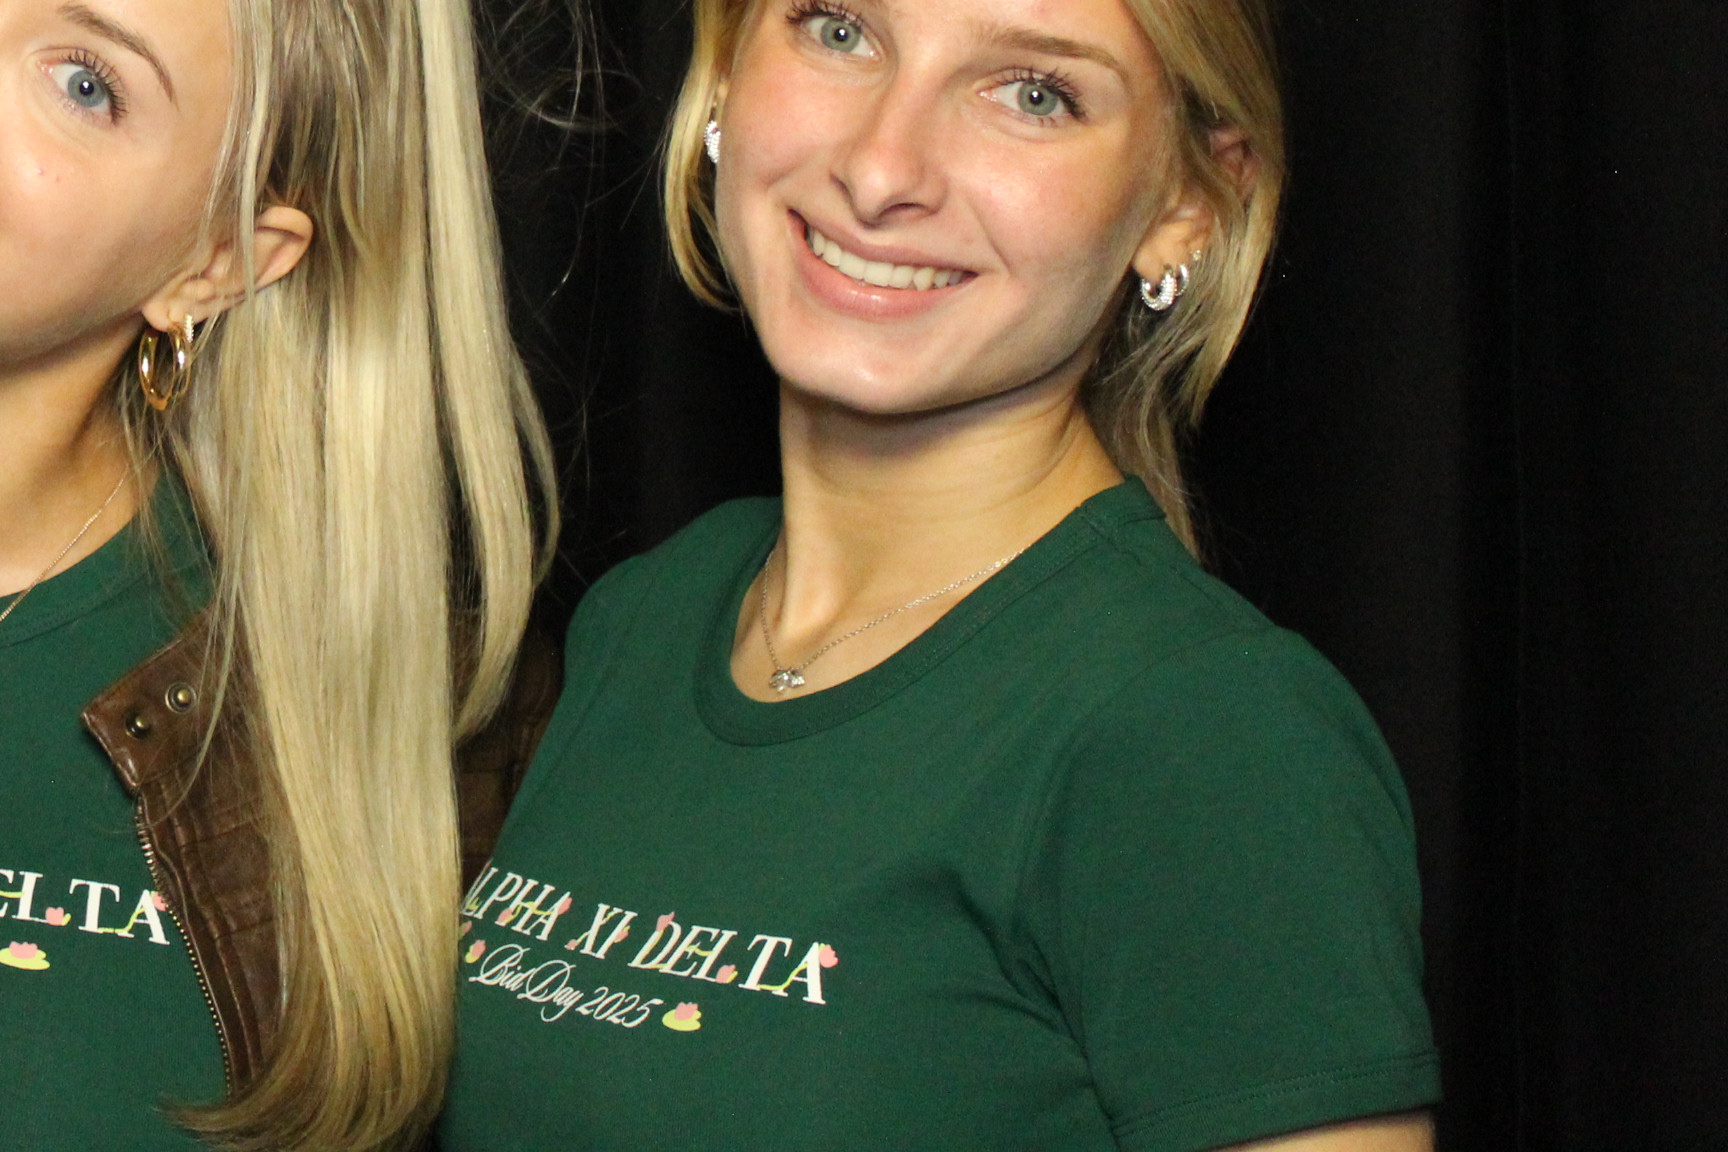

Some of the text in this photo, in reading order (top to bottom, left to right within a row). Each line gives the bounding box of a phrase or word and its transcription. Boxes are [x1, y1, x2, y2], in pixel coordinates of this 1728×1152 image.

[461, 866, 826, 1005] LPHA XI DELTA
[468, 943, 665, 1028] Bid Day 2025
